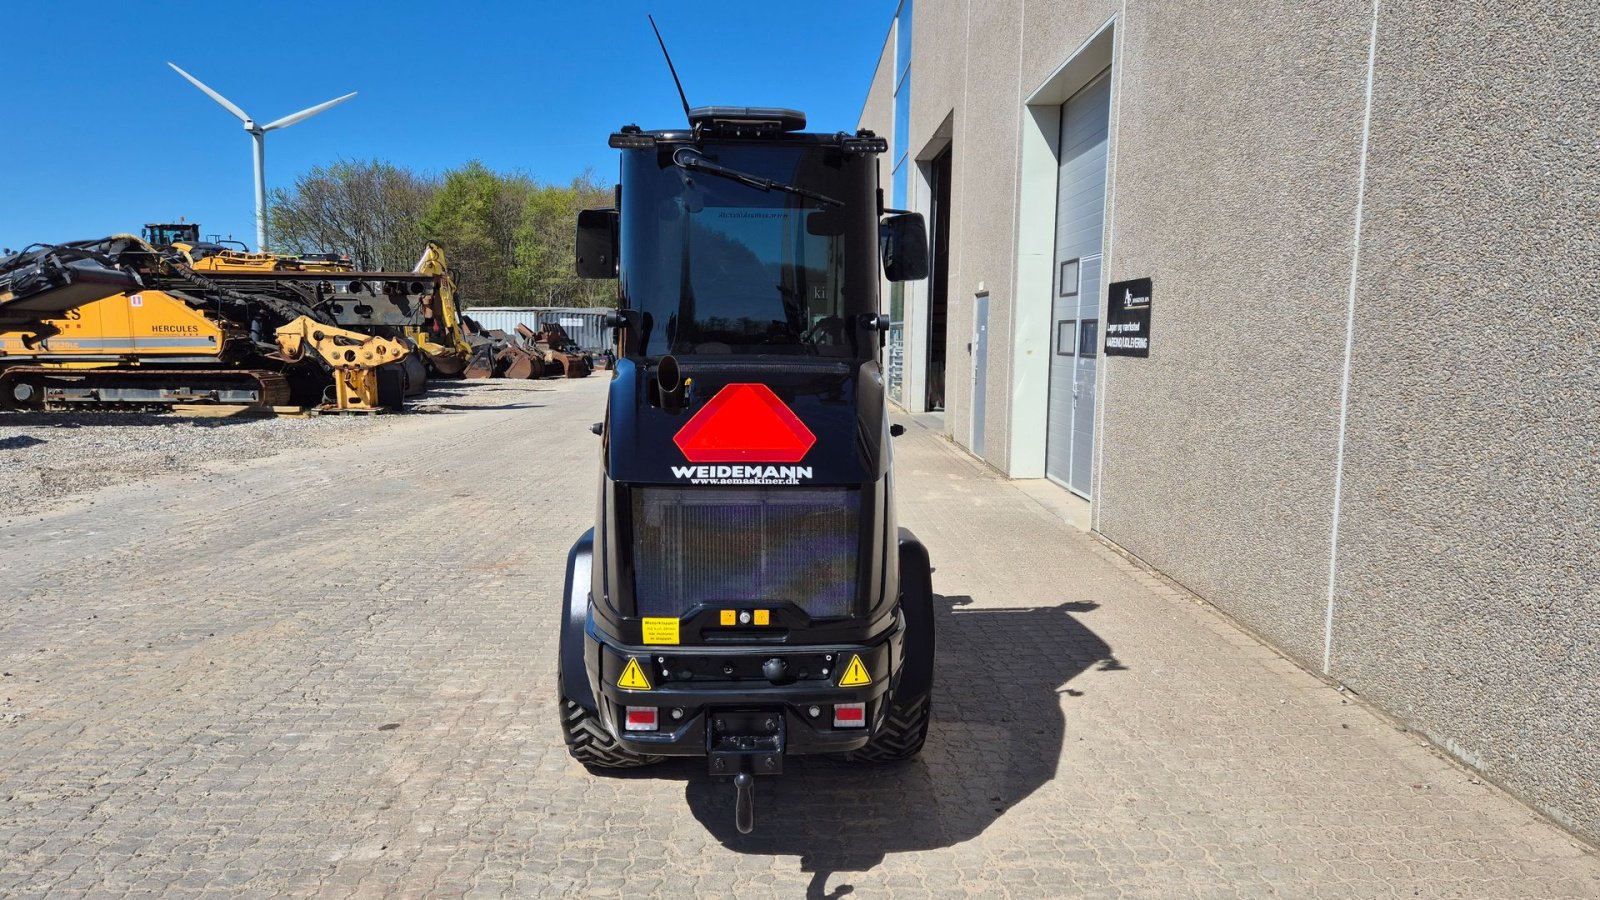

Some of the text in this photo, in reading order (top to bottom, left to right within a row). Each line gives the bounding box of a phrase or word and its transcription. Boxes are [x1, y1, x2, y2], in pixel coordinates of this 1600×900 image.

[151, 325, 199, 333] HERCULES
[671, 466, 813, 479] WEIDEMANN
[690, 477, 800, 485] www.aemaskiner.dk
